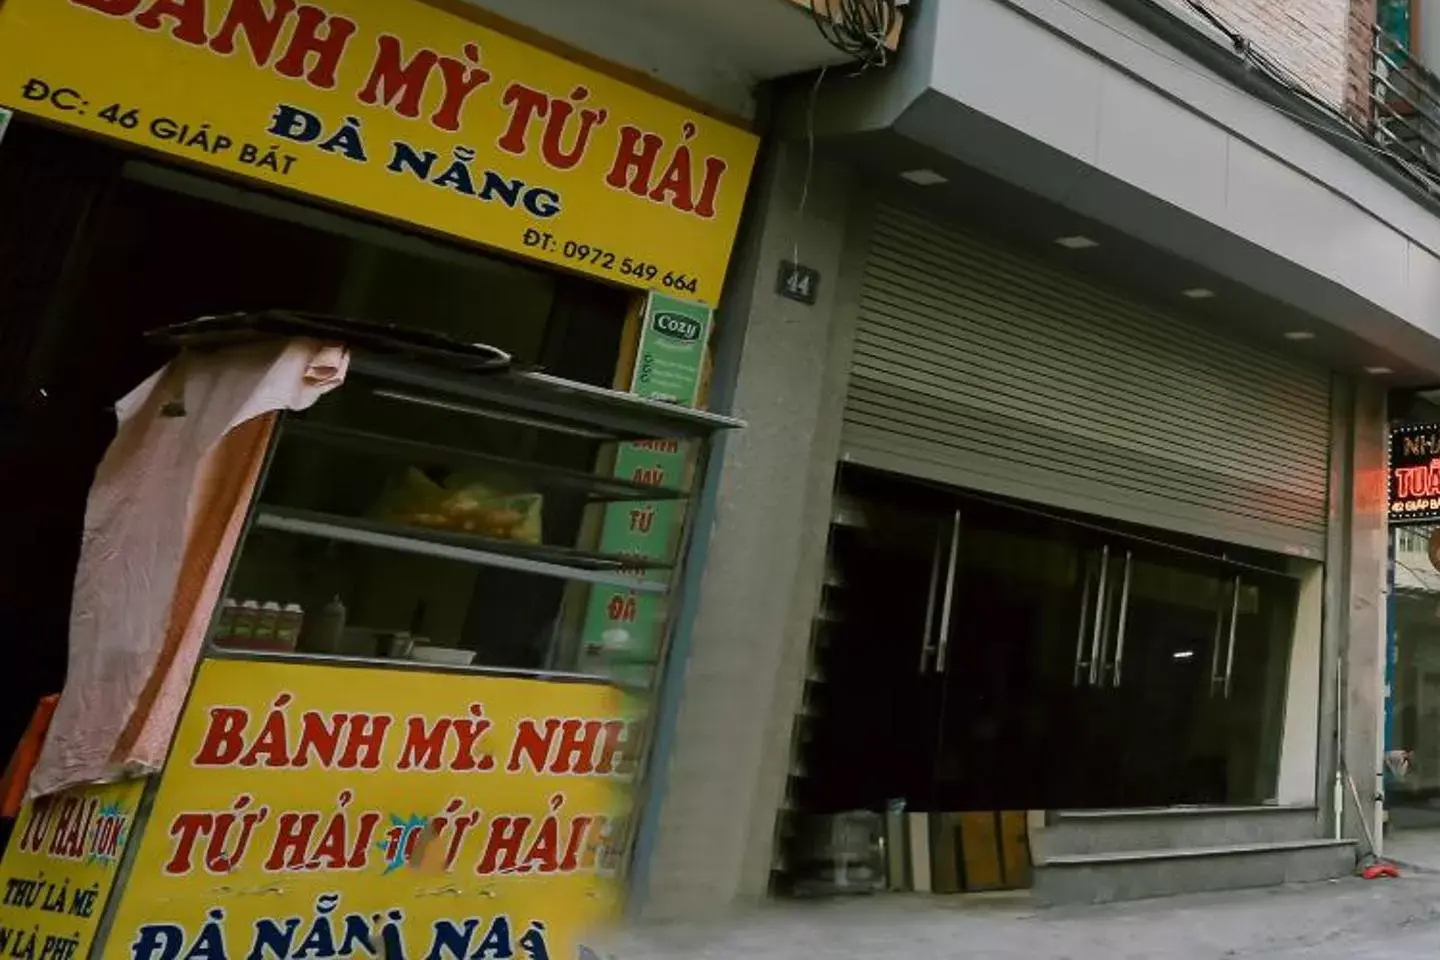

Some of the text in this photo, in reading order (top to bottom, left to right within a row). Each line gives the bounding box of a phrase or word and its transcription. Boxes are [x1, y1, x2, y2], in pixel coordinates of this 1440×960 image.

[21, 79, 297, 176] ĐC: 46 GIÁP BÁT
[267, 103, 561, 218] ĐÀ NẴNG
[358, 33, 490, 133] MỲ
[499, 80, 606, 170] TỨ
[606, 120, 727, 219] HẢI
[522, 227, 698, 296] ĐT: 0972 549 664
[658, 315, 697, 339] Cozy
[195, 694, 391, 769] BÁNH
[165, 795, 268, 874] TỨ
[265, 790, 380, 871] HẢI
[476, 794, 594, 874] HẢI
